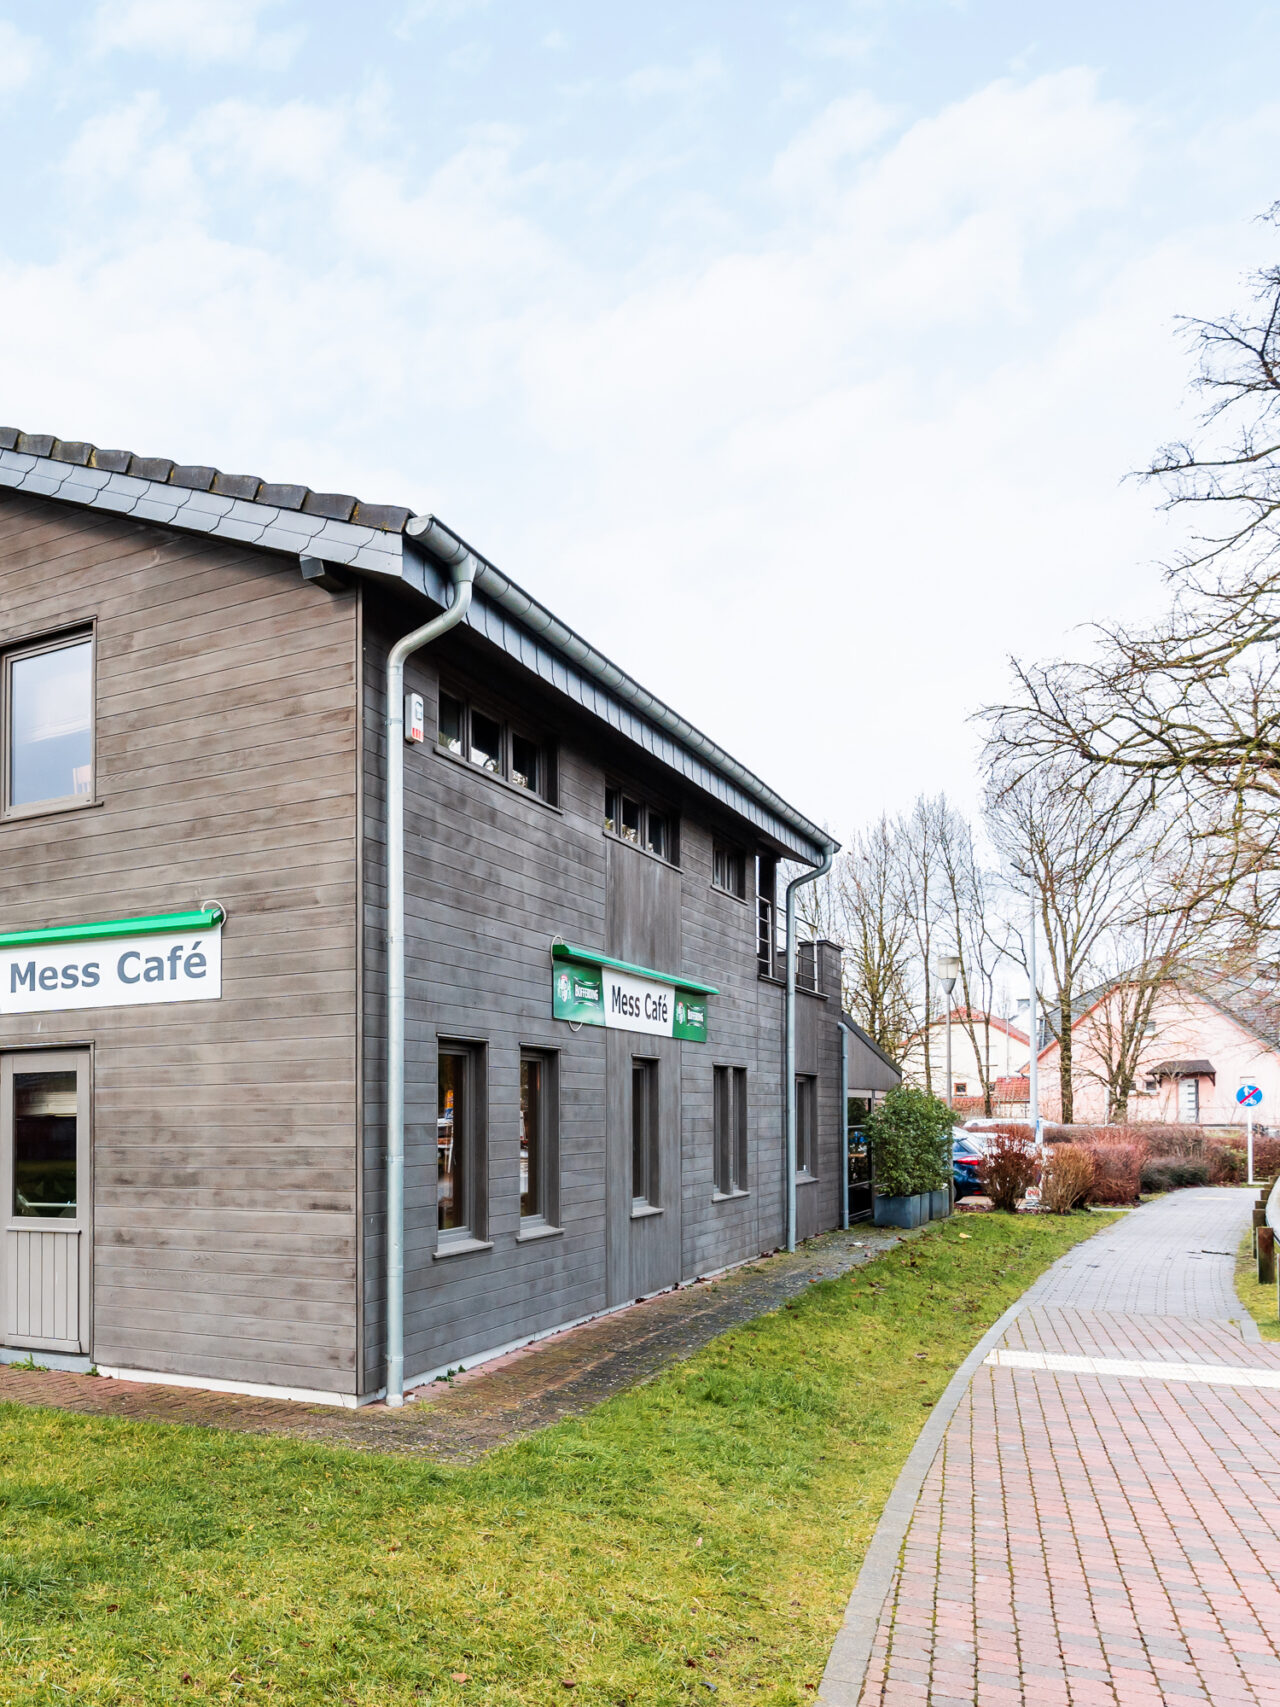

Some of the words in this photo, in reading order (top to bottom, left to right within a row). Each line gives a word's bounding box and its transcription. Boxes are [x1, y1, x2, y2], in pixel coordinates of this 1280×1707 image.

[10, 961, 100, 993] Mess
[117, 941, 207, 984] Café
[612, 985, 640, 1017] Mess
[644, 993, 667, 1022] Café
